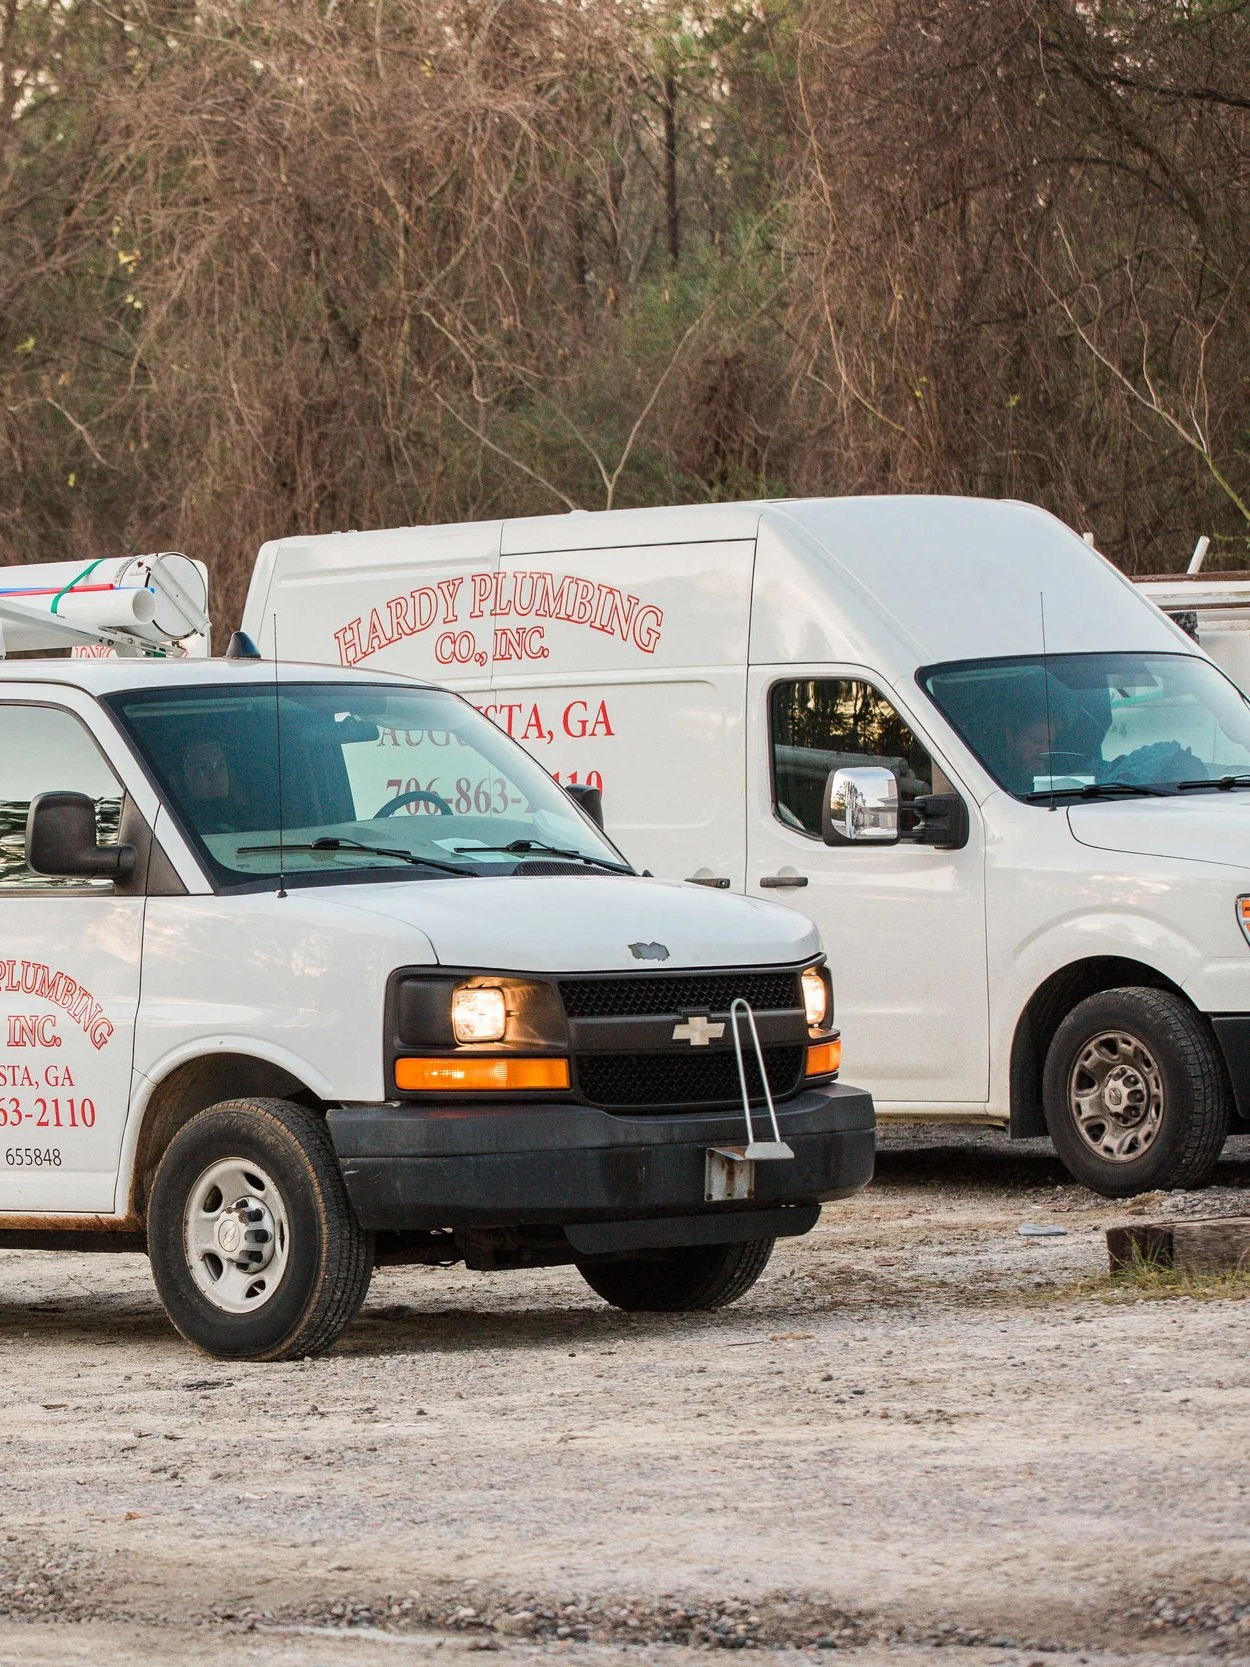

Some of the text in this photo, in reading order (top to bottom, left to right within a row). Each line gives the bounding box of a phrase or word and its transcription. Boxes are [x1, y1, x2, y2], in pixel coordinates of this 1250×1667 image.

[333, 571, 664, 667] HARDY PLUMBING
[434, 626, 550, 667] CO., INC.
[561, 700, 616, 739] GA
[6, 1015, 62, 1048] INC.
[44, 1065, 76, 1088] GA
[5, 1147, 63, 1167] 655848
